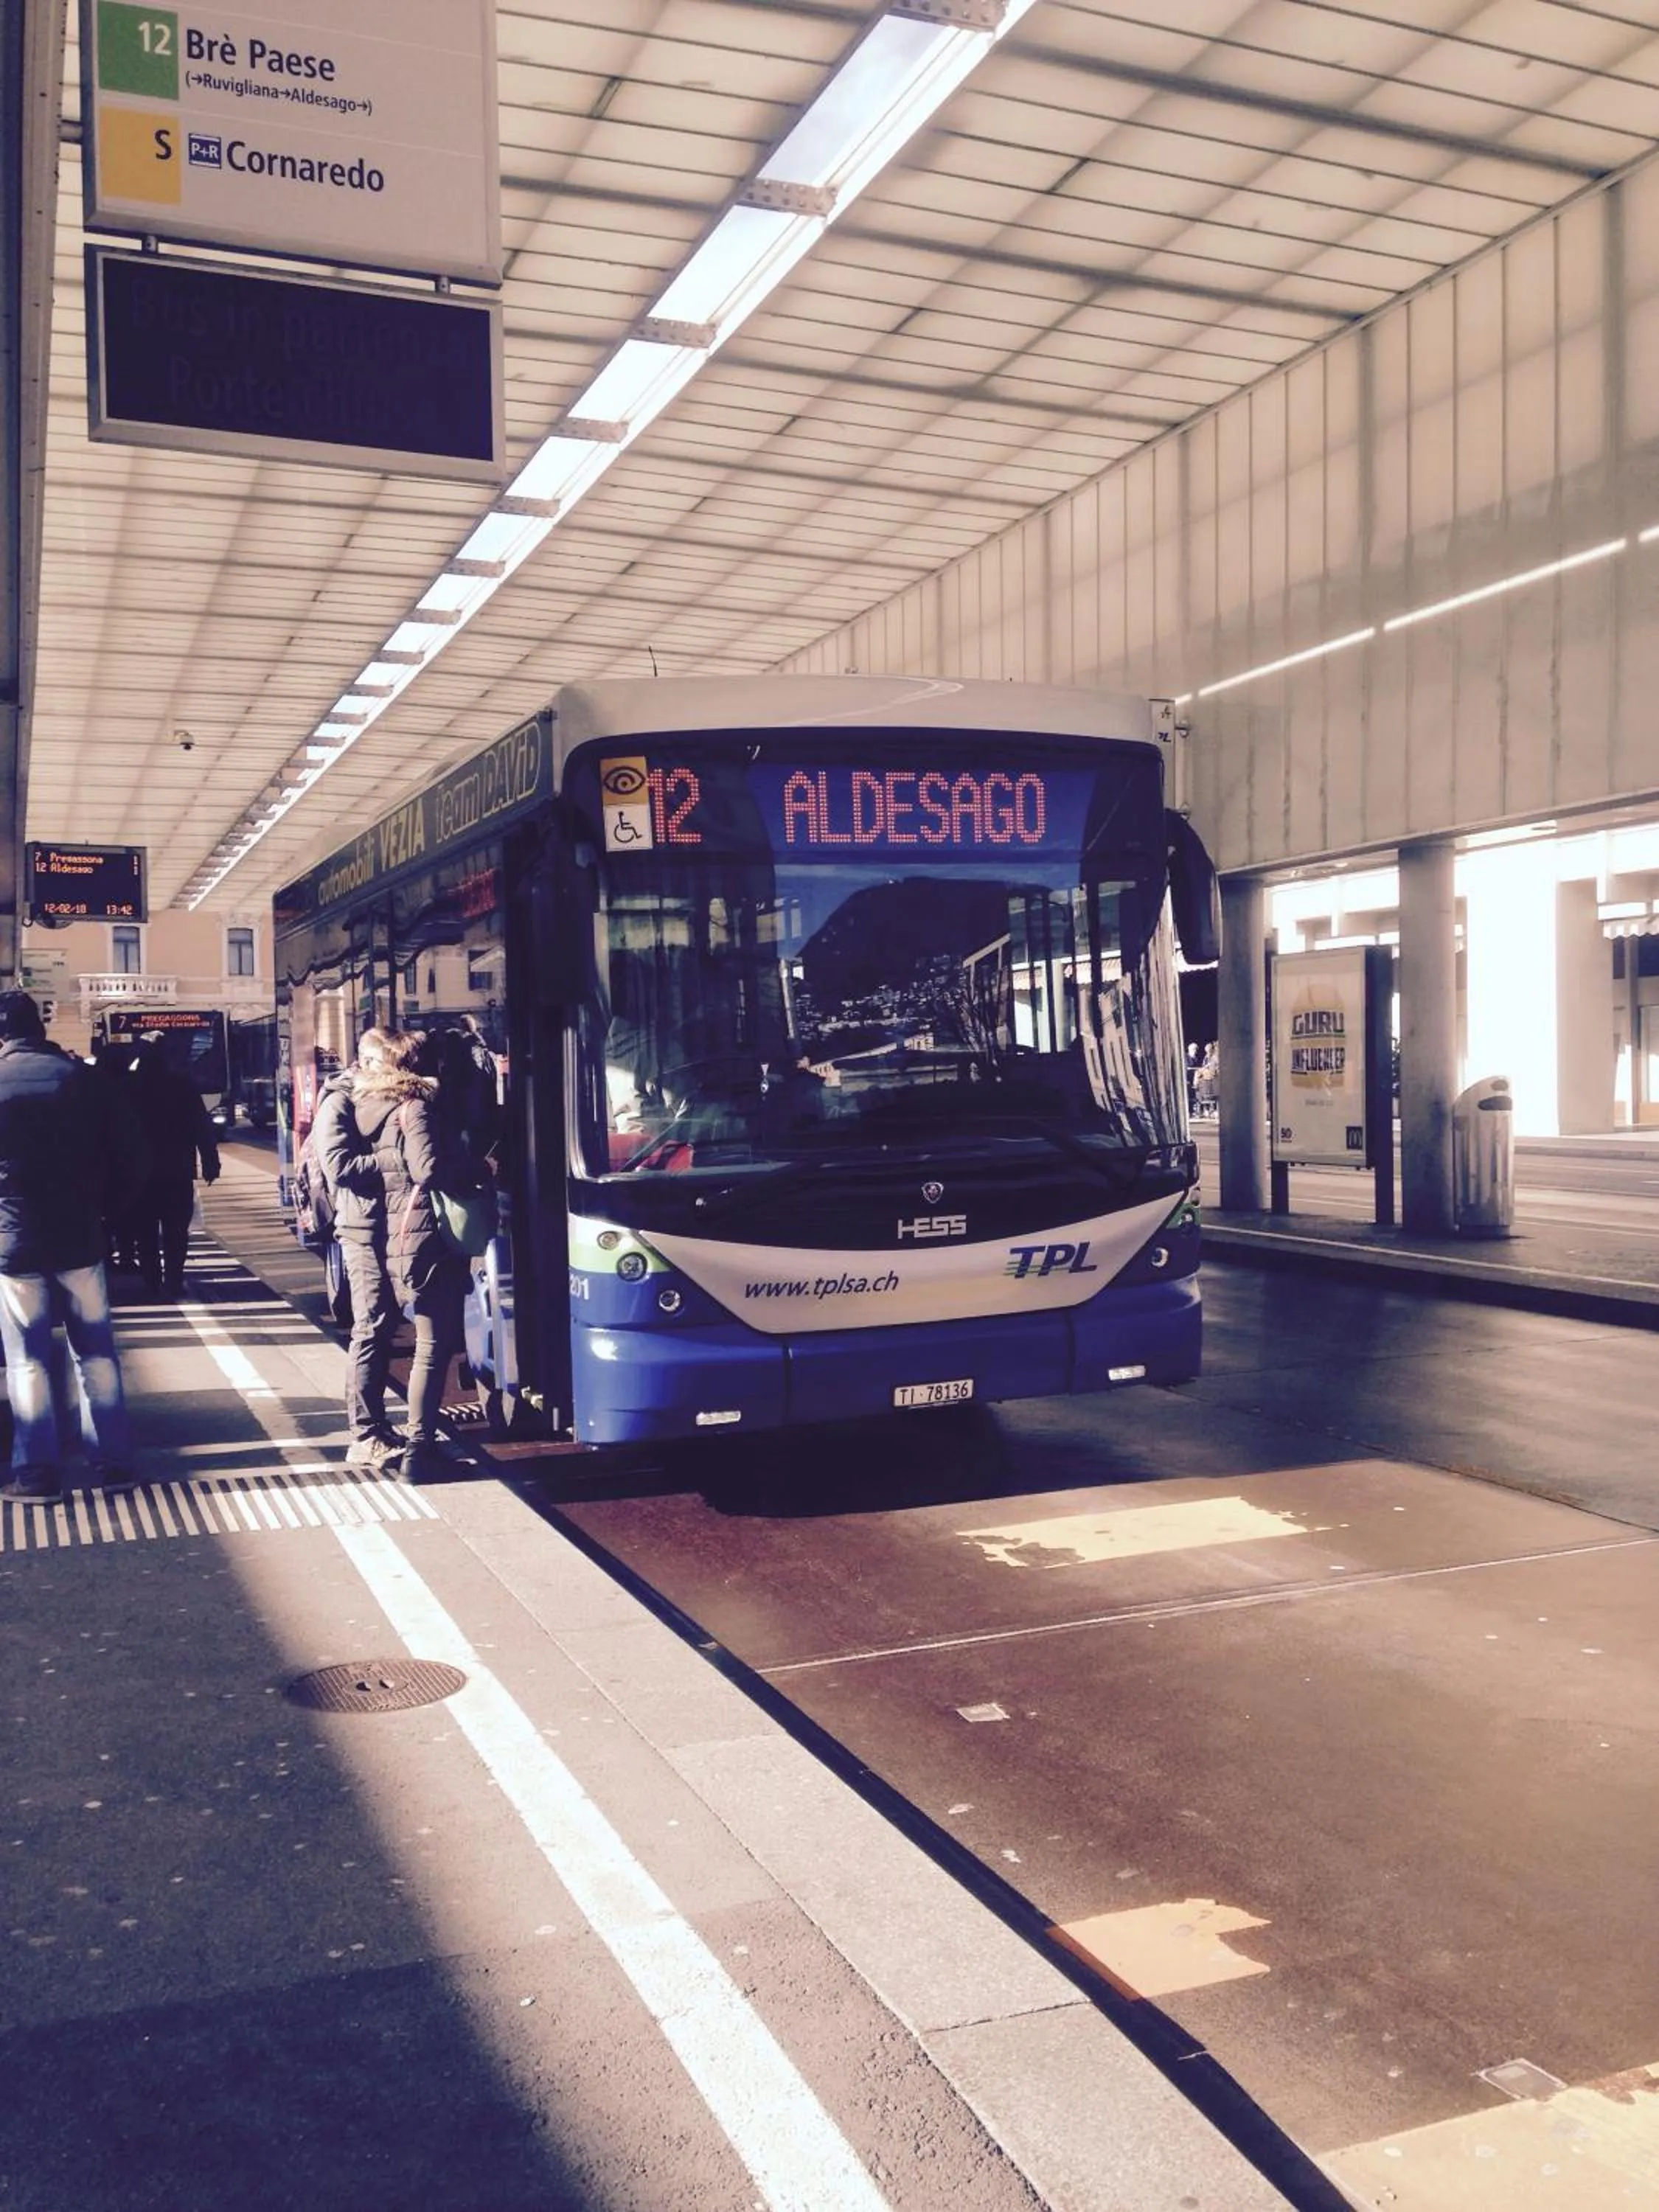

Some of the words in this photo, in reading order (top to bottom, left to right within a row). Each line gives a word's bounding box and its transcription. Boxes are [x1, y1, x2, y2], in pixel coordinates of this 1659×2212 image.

[139, 21, 172, 55] 12
[186, 28, 237, 66] Brè
[248, 39, 335, 82] Paese
[204, 74, 279, 97] Ruvigliana
[290, 88, 357, 114] Aldesago
[153, 129, 172, 161] S
[190, 142, 219, 160] P+R
[226, 140, 385, 192] Cornaredo
[644, 768, 703, 843] 12
[784, 771, 1046, 843] ALDESAGO
[379, 797, 425, 873] VEZIA
[35, 862, 47, 872] 12
[106, 904, 133, 914] 13:42
[1292, 1010, 1344, 1035] GURU
[897, 1214, 967, 1239] HESS
[745, 1270, 900, 1299] www.tplsa.ch
[1009, 1242, 1097, 1279] TPL
[926, 1381, 968, 1402] 78136
